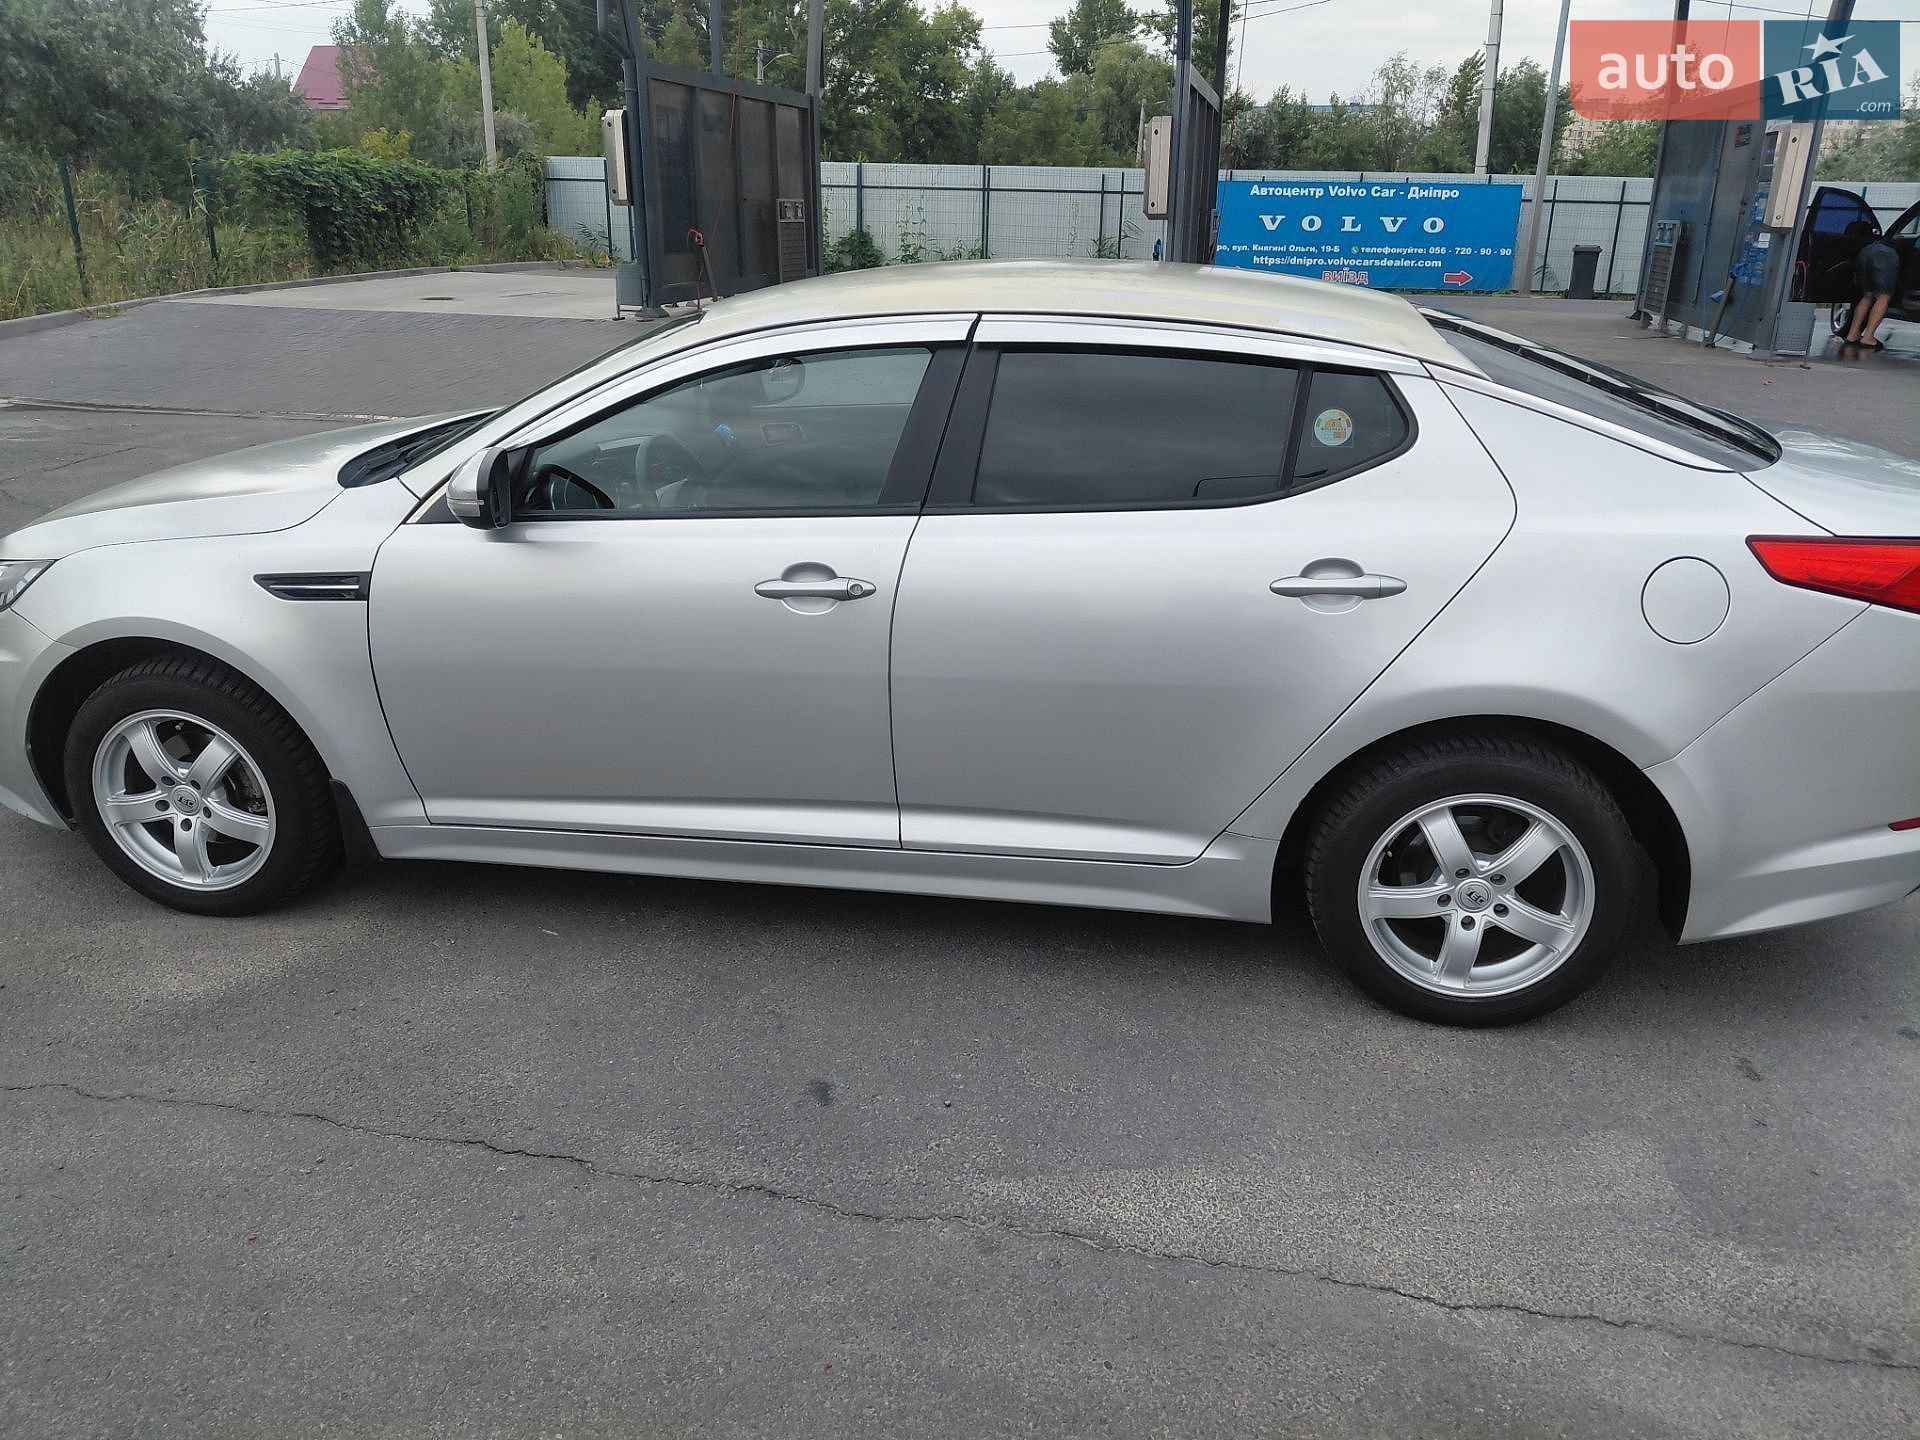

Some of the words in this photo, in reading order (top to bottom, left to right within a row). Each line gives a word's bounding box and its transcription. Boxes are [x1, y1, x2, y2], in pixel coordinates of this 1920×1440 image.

[1250, 185, 1324, 198] Автоцентр
[1329, 185, 1366, 197] Volvo
[1371, 186, 1396, 197] Car
[1407, 187, 1460, 200] Дніпро
[1259, 215, 1445, 233] VOLVO
[1360, 246, 1427, 255] телефонуйте:
[1429, 246, 1447, 255] 056
[1455, 247, 1472, 256] 720
[1480, 247, 1492, 256] 90
[1500, 248, 1512, 257] 90
[1253, 255, 1442, 268] https://dnipro.volvocarsdealer.com
